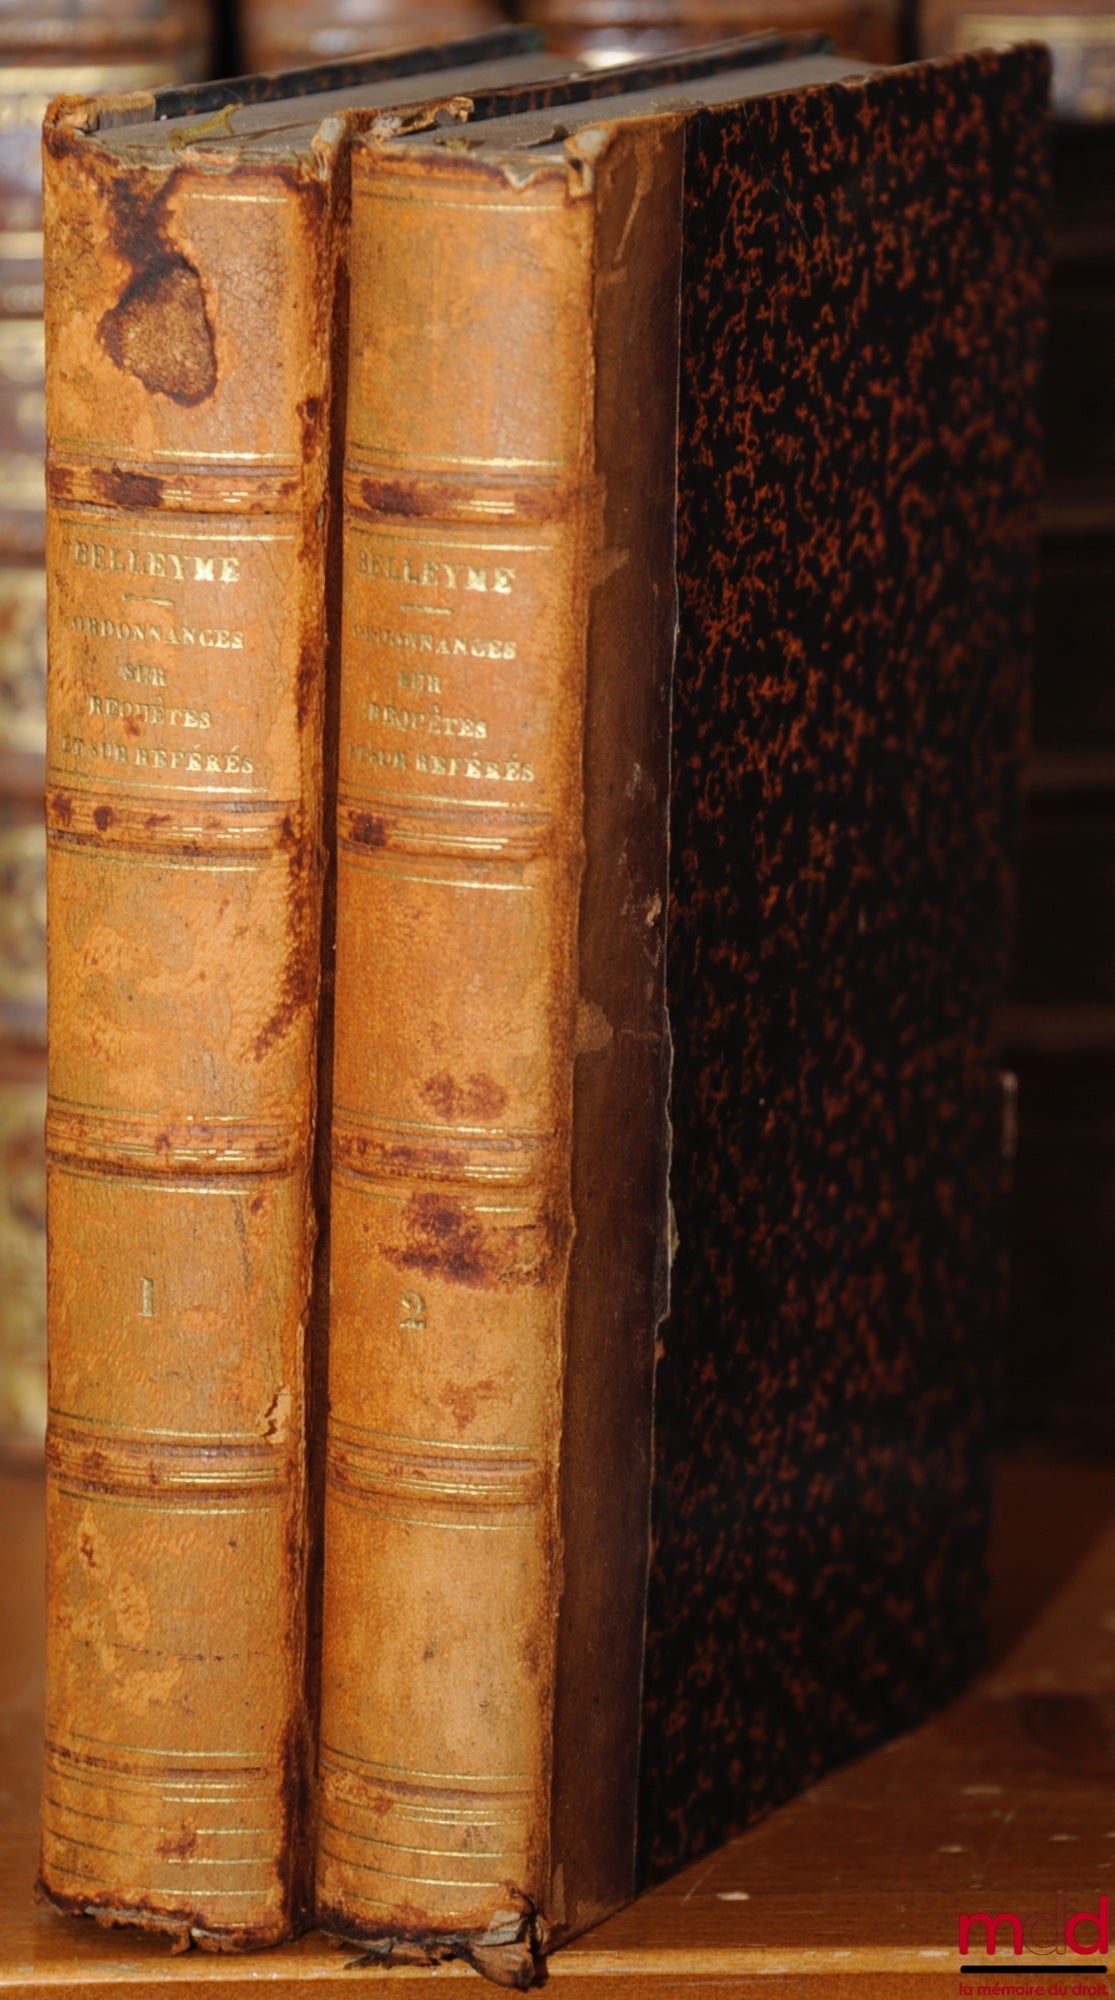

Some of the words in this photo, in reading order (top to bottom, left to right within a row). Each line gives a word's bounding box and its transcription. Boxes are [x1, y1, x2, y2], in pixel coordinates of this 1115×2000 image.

[74, 540, 241, 582] BELLEYME
[356, 549, 517, 594] BELLEYME
[72, 615, 244, 649] ORDONNANCES
[121, 662, 167, 687] SUR
[367, 702, 488, 739] REQUÊTES
[400, 1291, 427, 1330] 2
